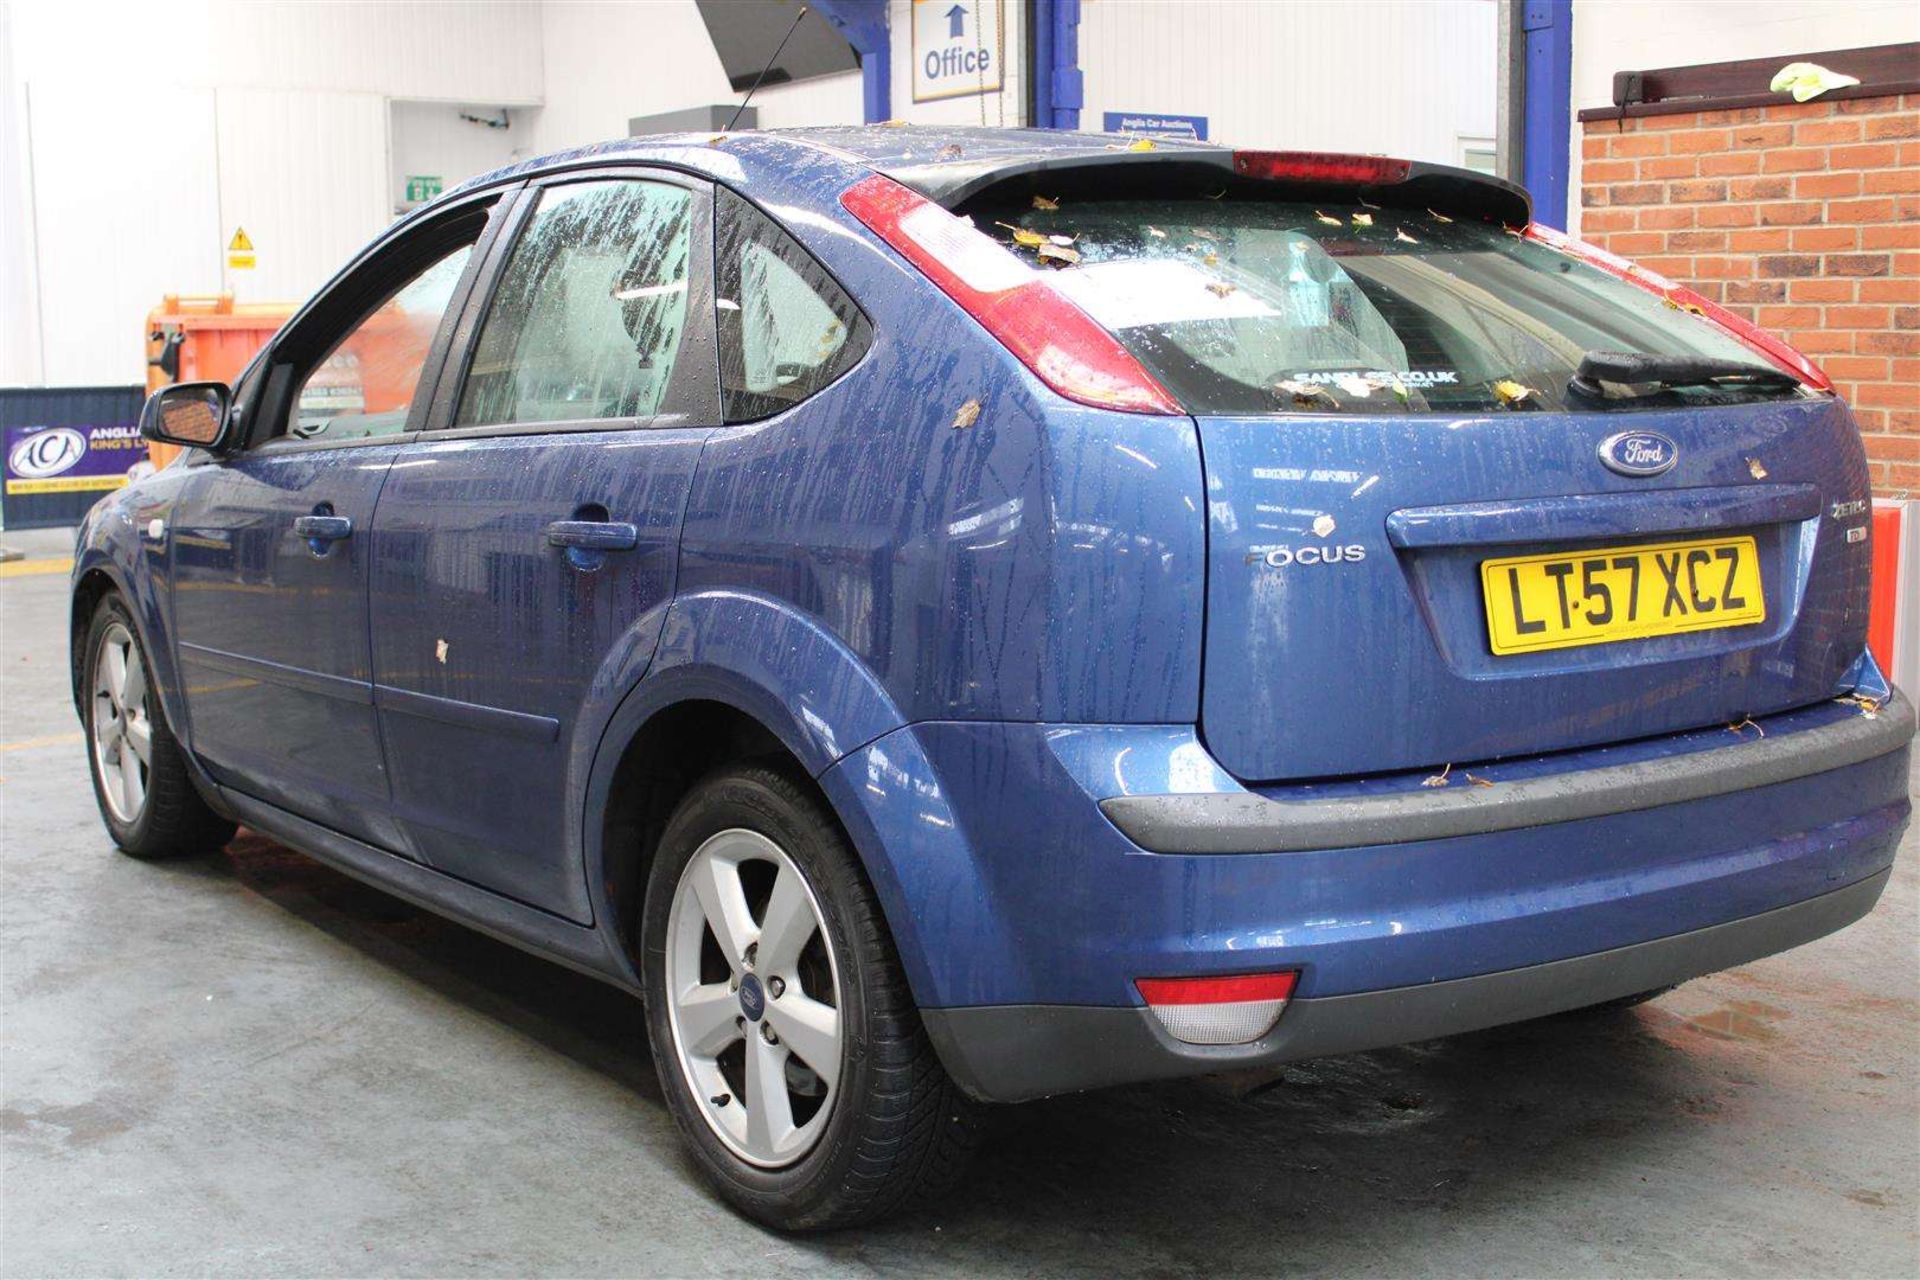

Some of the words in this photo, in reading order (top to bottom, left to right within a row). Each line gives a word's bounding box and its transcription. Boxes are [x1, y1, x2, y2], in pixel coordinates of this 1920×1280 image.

[925, 46, 990, 80] Office
[1624, 439, 1664, 463] Ford
[1245, 544, 1366, 567] FOCUS
[1508, 555, 1640, 635] LT57
[1655, 546, 1747, 618] XCZ
